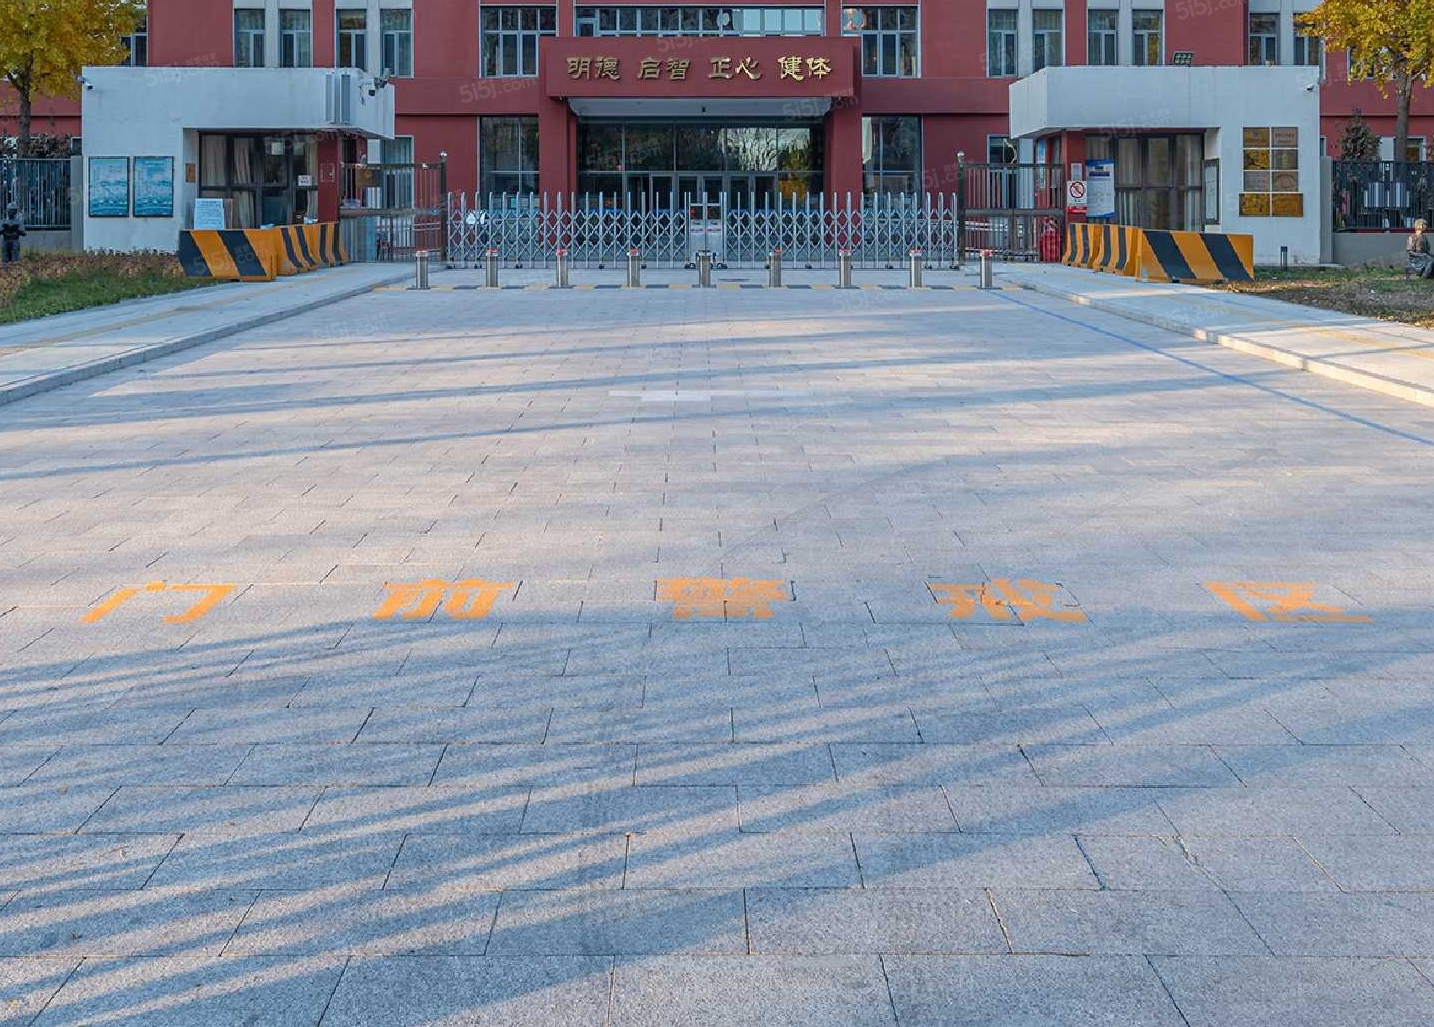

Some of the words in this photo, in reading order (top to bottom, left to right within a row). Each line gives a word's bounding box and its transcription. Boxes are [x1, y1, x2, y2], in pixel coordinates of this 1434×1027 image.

[636, 56, 691, 81] 启智
[707, 56, 762, 80] 正心
[776, 55, 832, 83] 健体
